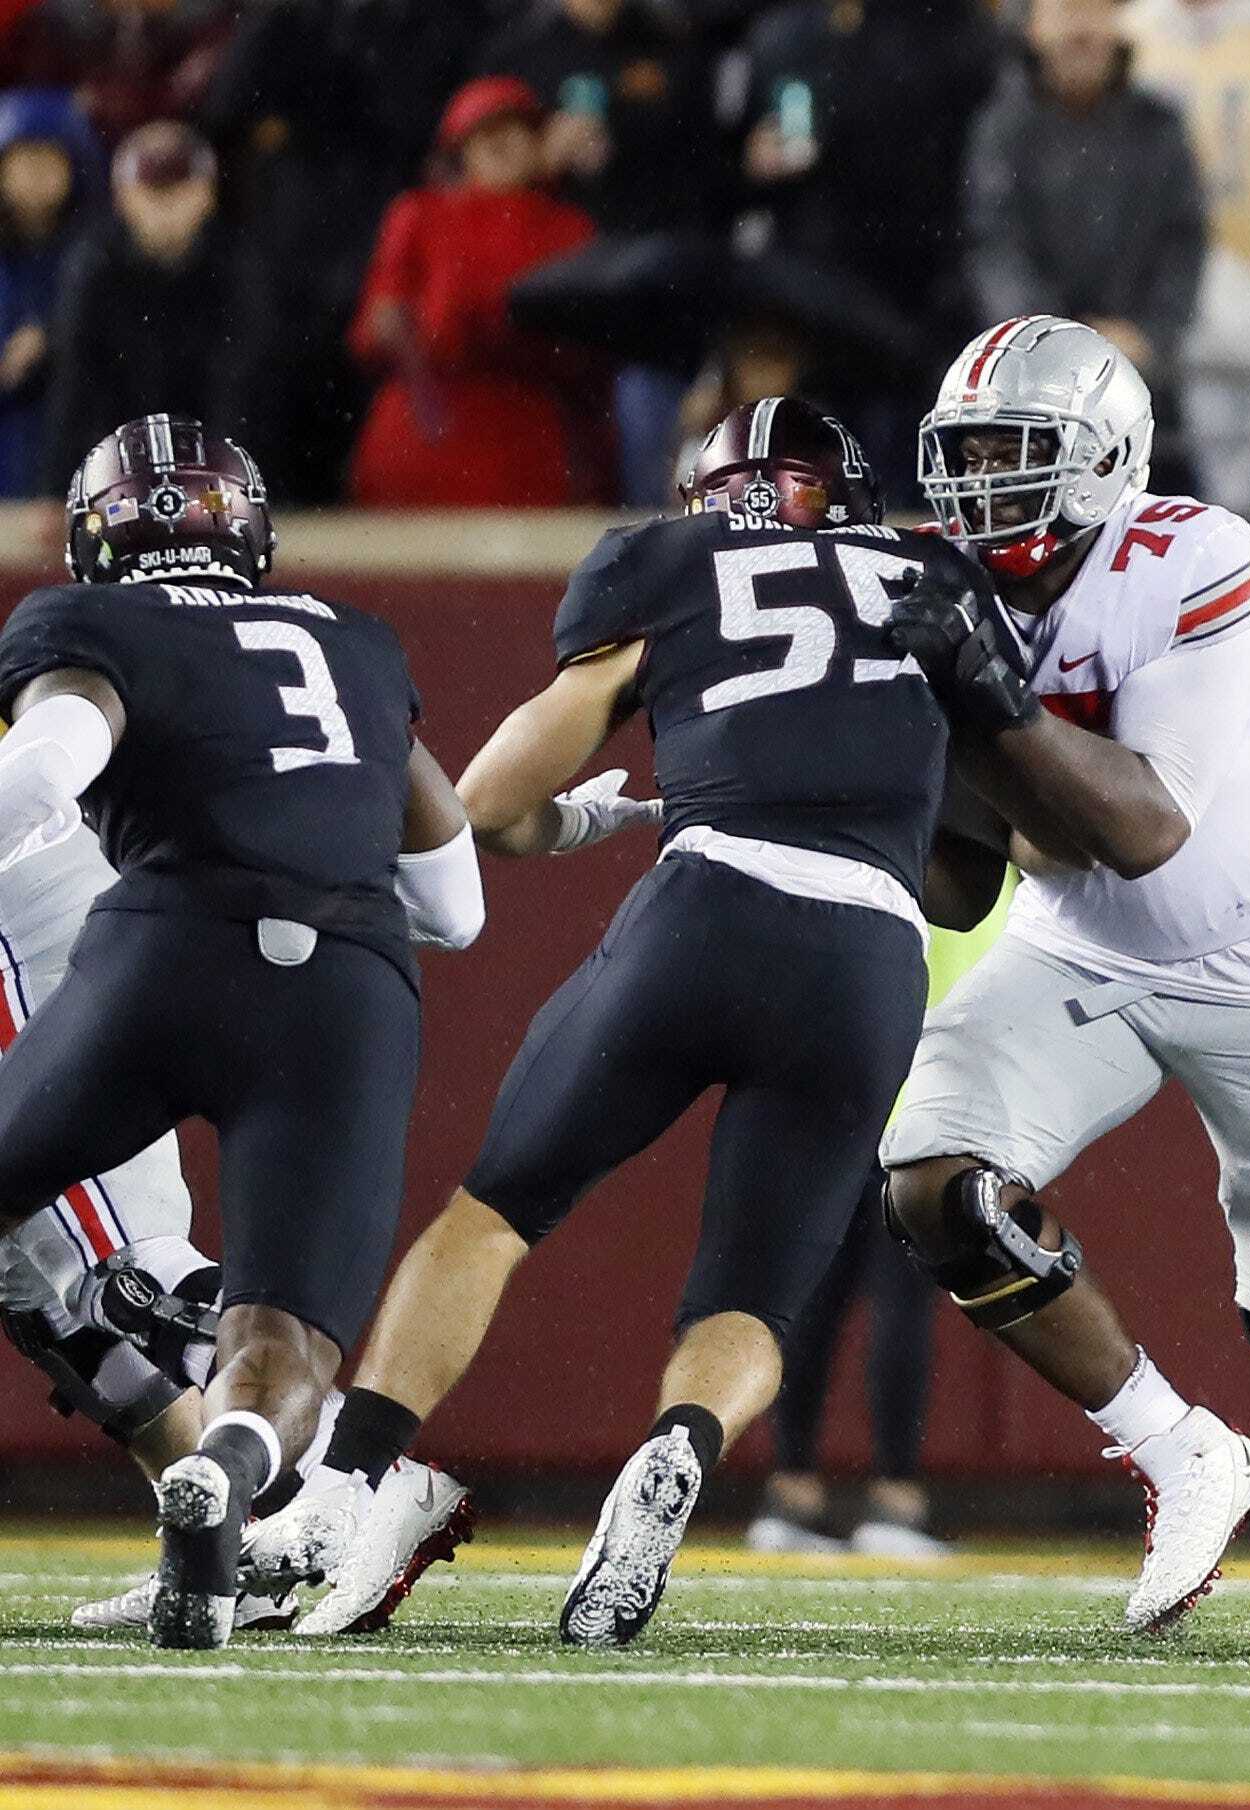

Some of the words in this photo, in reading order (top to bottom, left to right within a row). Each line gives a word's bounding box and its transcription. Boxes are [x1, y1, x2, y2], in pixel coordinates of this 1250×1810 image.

[162, 494, 175, 512] 3
[749, 491, 770, 509] 55
[138, 546, 212, 570] SKI-U-MAR
[1109, 500, 1209, 572] 75
[701, 541, 929, 713] 55
[232, 620, 362, 773] 3
